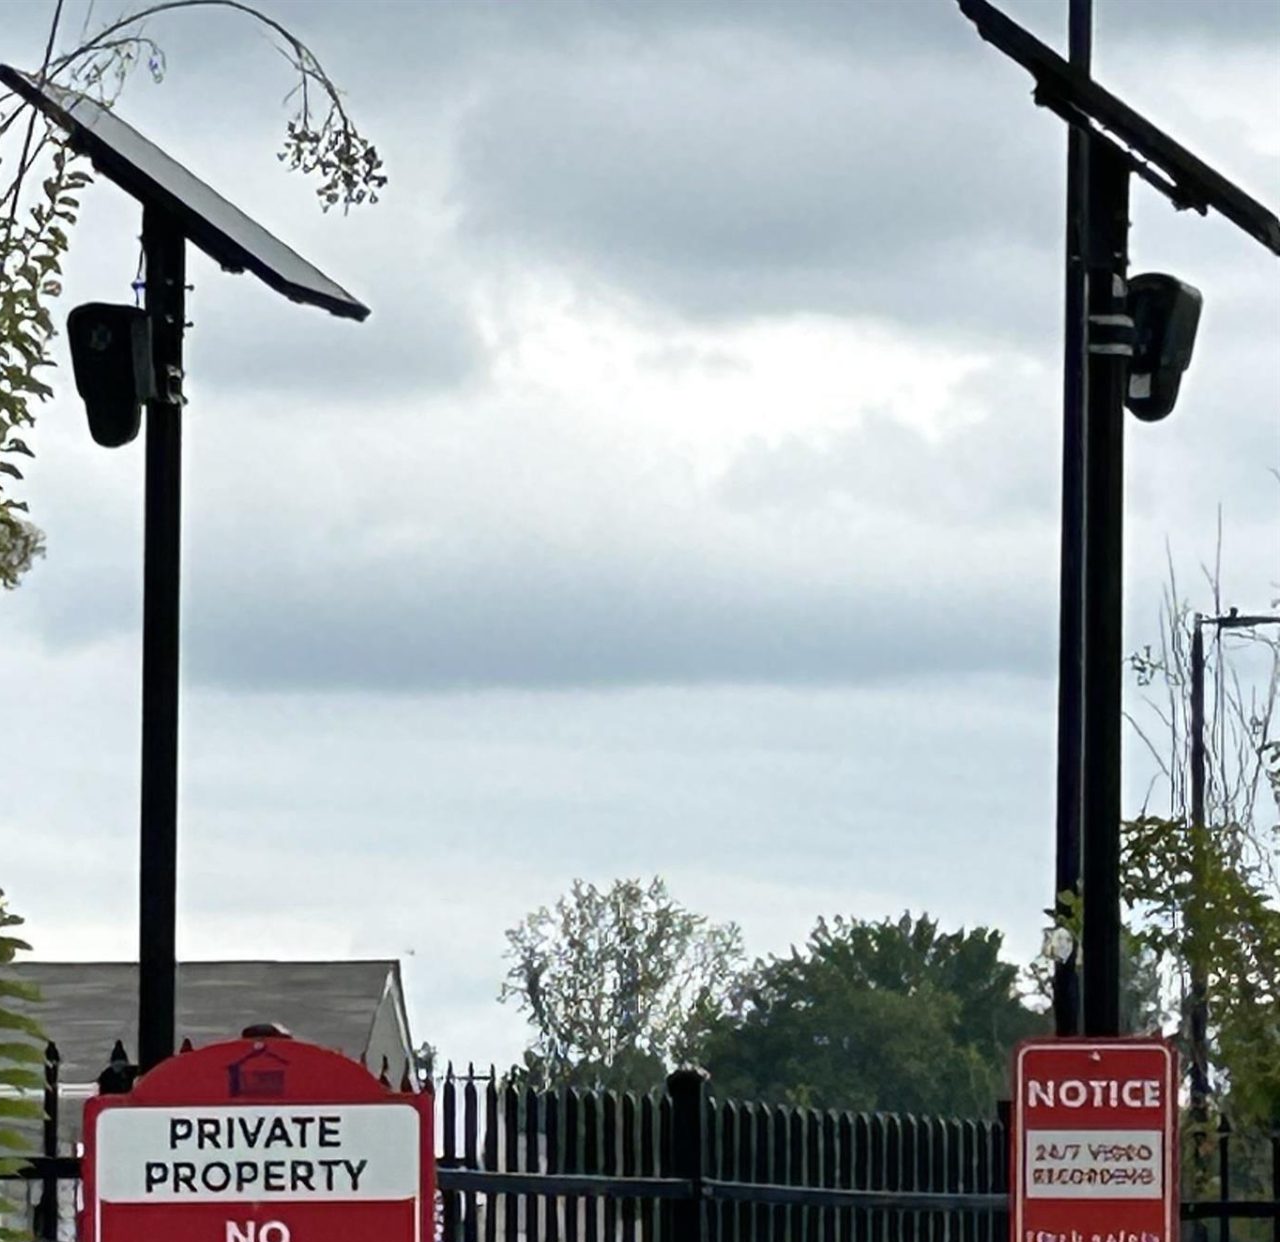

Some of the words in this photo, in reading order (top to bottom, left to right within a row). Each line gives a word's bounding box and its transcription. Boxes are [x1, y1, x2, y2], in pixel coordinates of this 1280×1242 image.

[1027, 1079, 1160, 1108] NOTICE
[169, 1116, 342, 1149] PRIVATE
[145, 1159, 368, 1193] PROPERTY
